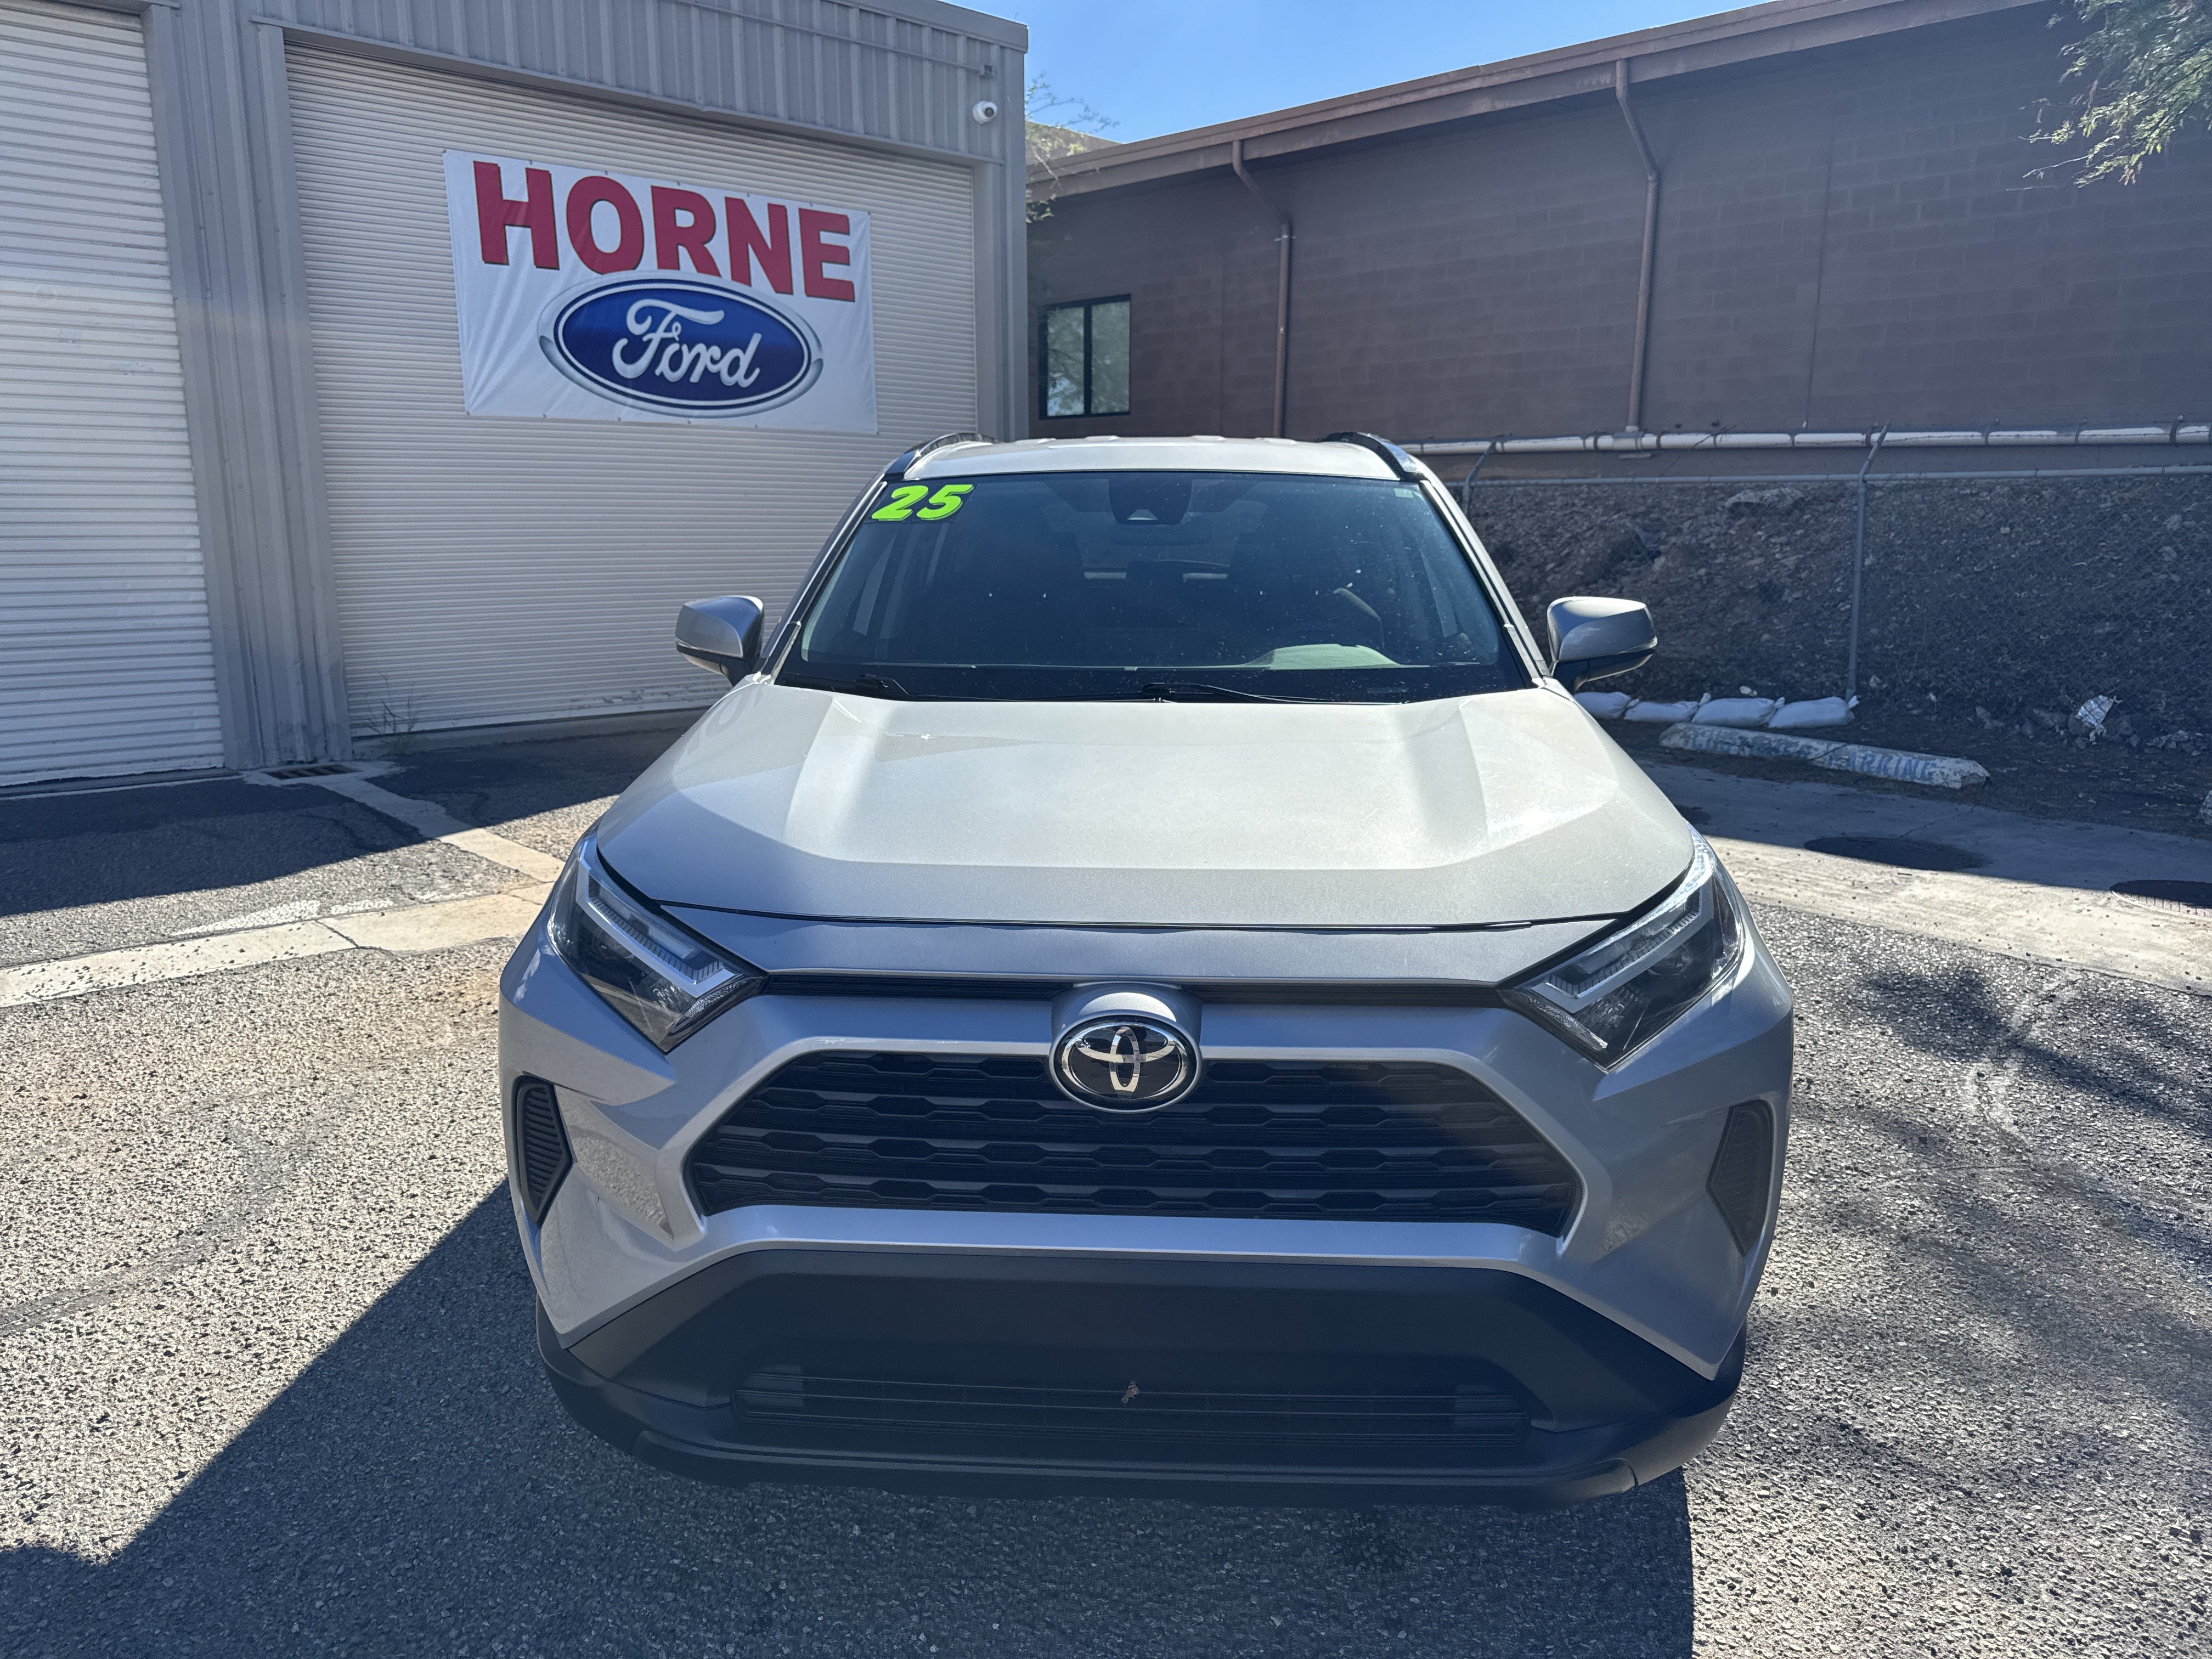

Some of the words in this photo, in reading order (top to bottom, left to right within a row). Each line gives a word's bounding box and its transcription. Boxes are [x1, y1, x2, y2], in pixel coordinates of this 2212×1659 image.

[473, 161, 855, 302] HORNE
[612, 298, 762, 388] Ford
[872, 484, 974, 521] 25
